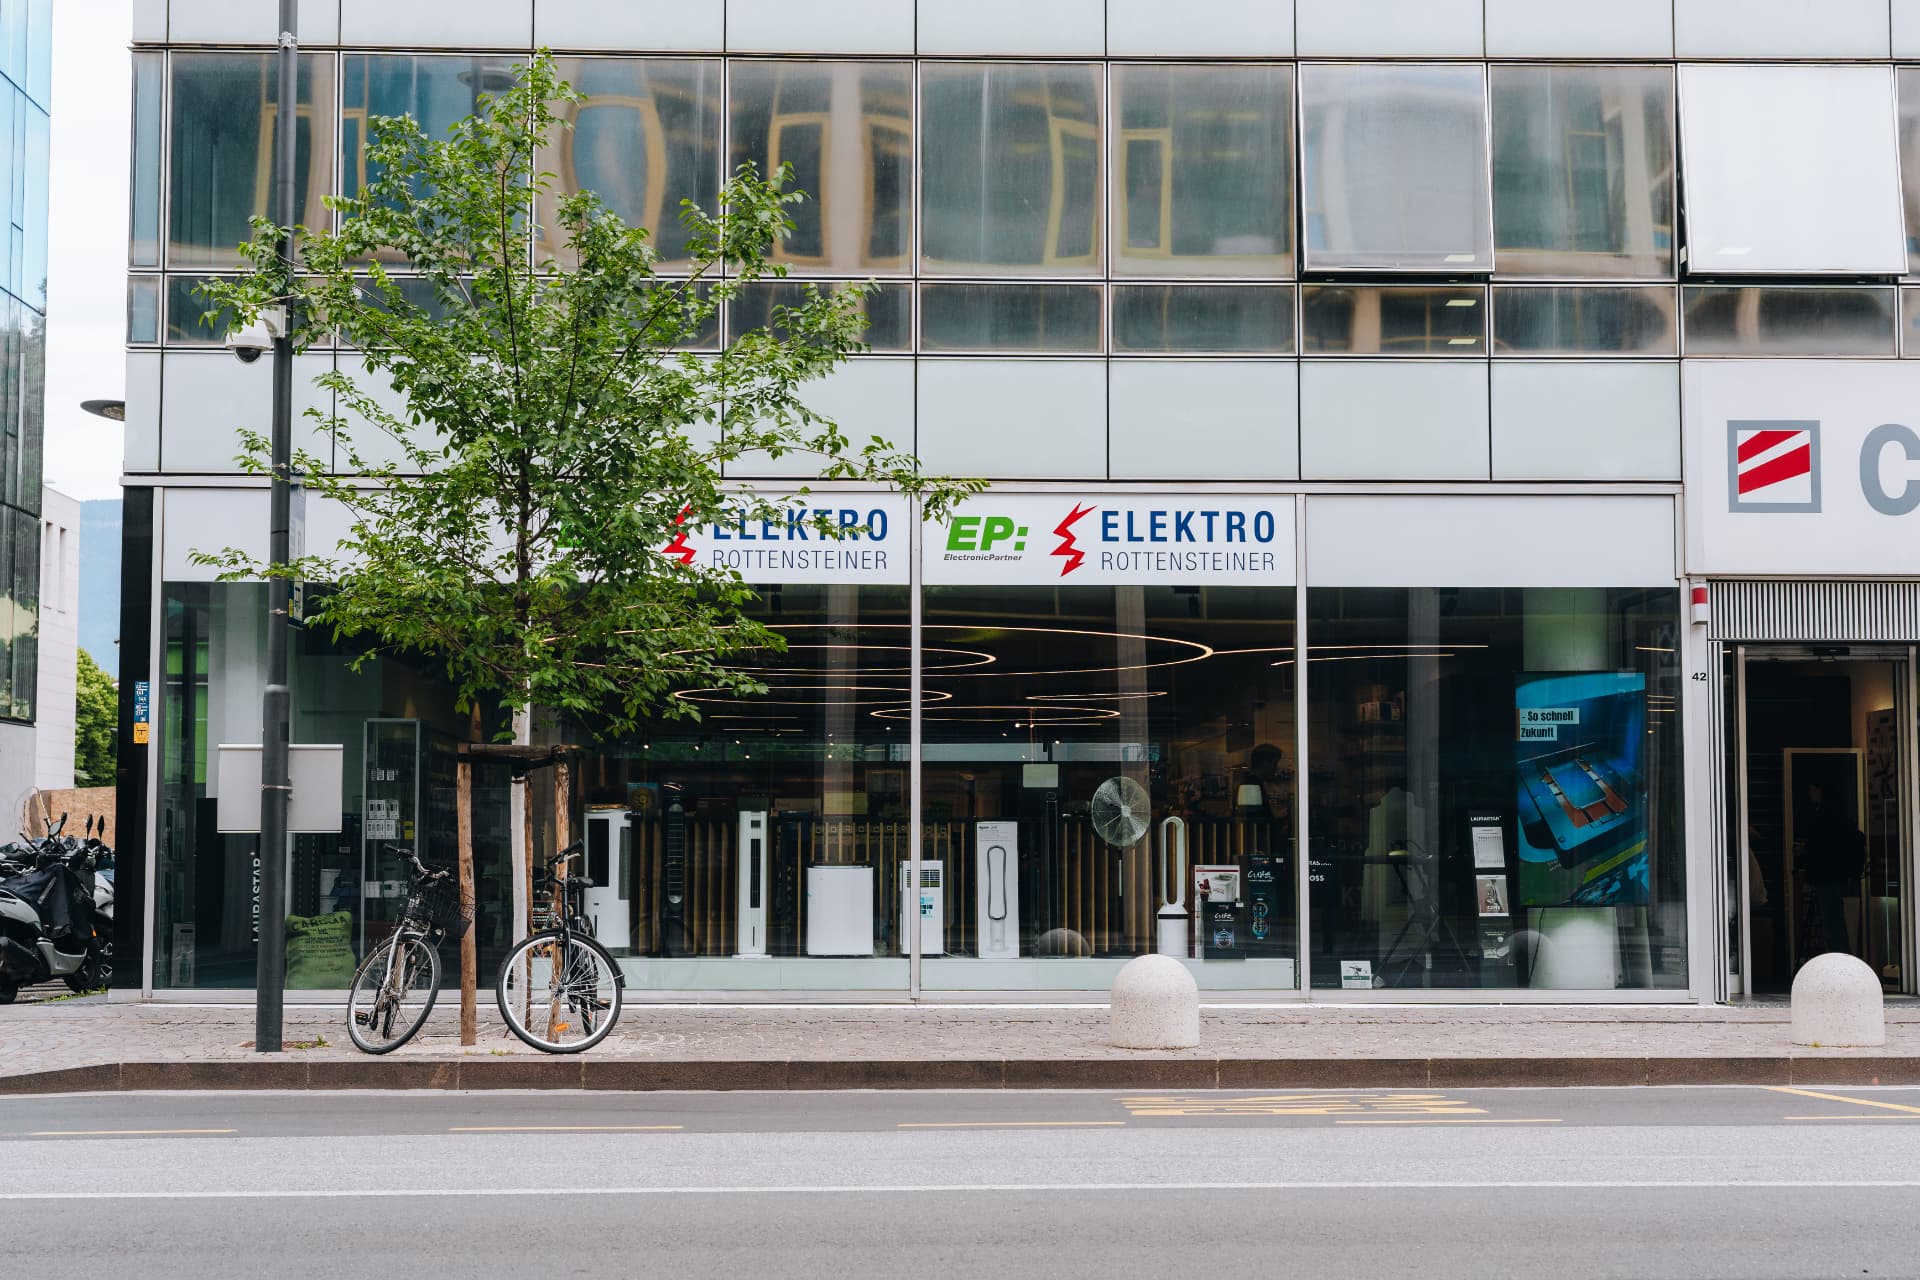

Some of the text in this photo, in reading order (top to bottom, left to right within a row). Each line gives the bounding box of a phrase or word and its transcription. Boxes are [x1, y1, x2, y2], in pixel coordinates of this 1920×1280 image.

[1101, 510, 1275, 542] ELEKTRO
[946, 517, 1029, 551] EP:
[713, 549, 887, 569] ROTTENSTEINER
[943, 553, 1023, 561] ElectronicPartner
[1101, 551, 1275, 571] ROTTENSTEINER
[1691, 672, 1707, 681] 42
[1527, 711, 1539, 721] So
[1540, 711, 1574, 721] schnell
[1520, 727, 1554, 738] Zukunft
